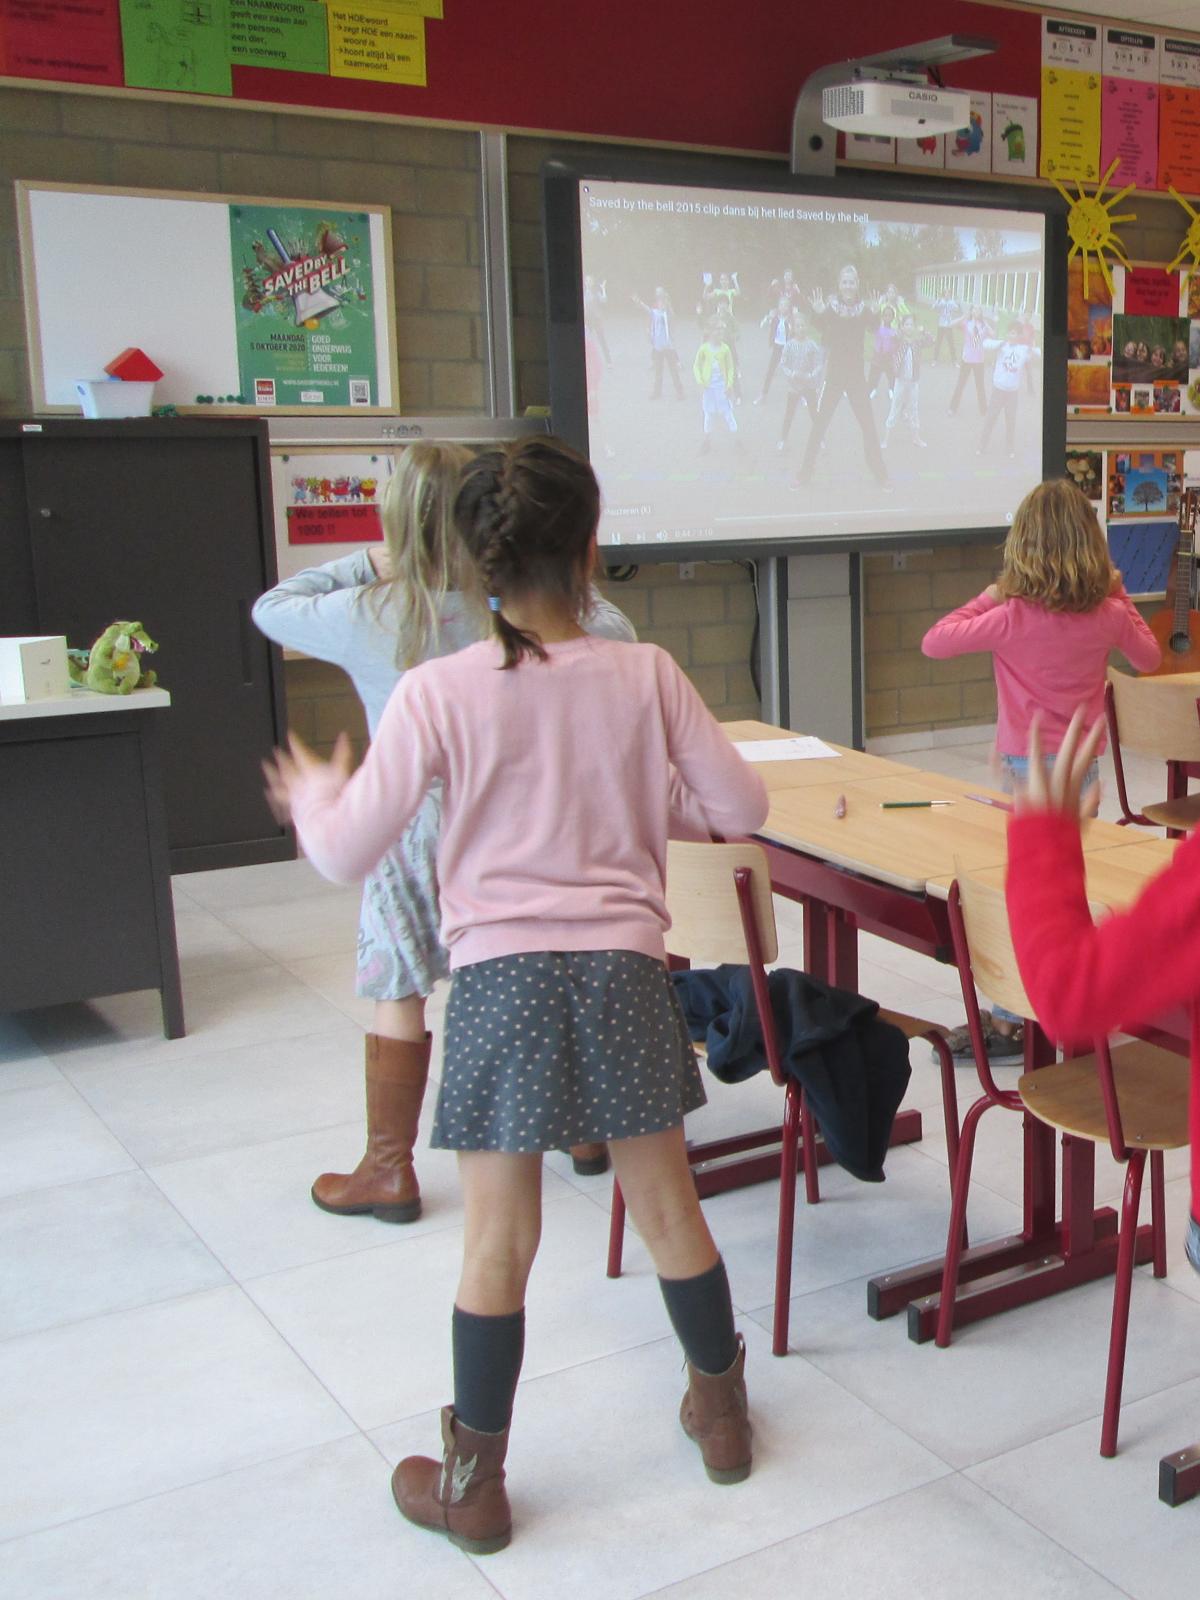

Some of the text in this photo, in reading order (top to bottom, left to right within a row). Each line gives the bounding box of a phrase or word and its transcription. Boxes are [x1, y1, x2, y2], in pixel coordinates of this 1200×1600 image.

[361, 27, 379, 36] HOE
[343, 37, 367, 46] woord
[366, 51, 385, 61] altijd
[386, 52, 396, 62] bij
[397, 55, 411, 63] een
[908, 91, 938, 102] CASIO
[589, 196, 869, 224] Saved by the bell 2015 clip dans bij het lied Saved by the bell
[263, 255, 328, 296] SAVED BY
[287, 256, 351, 296] THE BELL
[270, 333, 305, 343] MAANDAG
[311, 335, 331, 344] GOED
[255, 343, 288, 351] OKTOBER
[287, 343, 306, 351] 2020
[312, 353, 332, 363] VOOR
